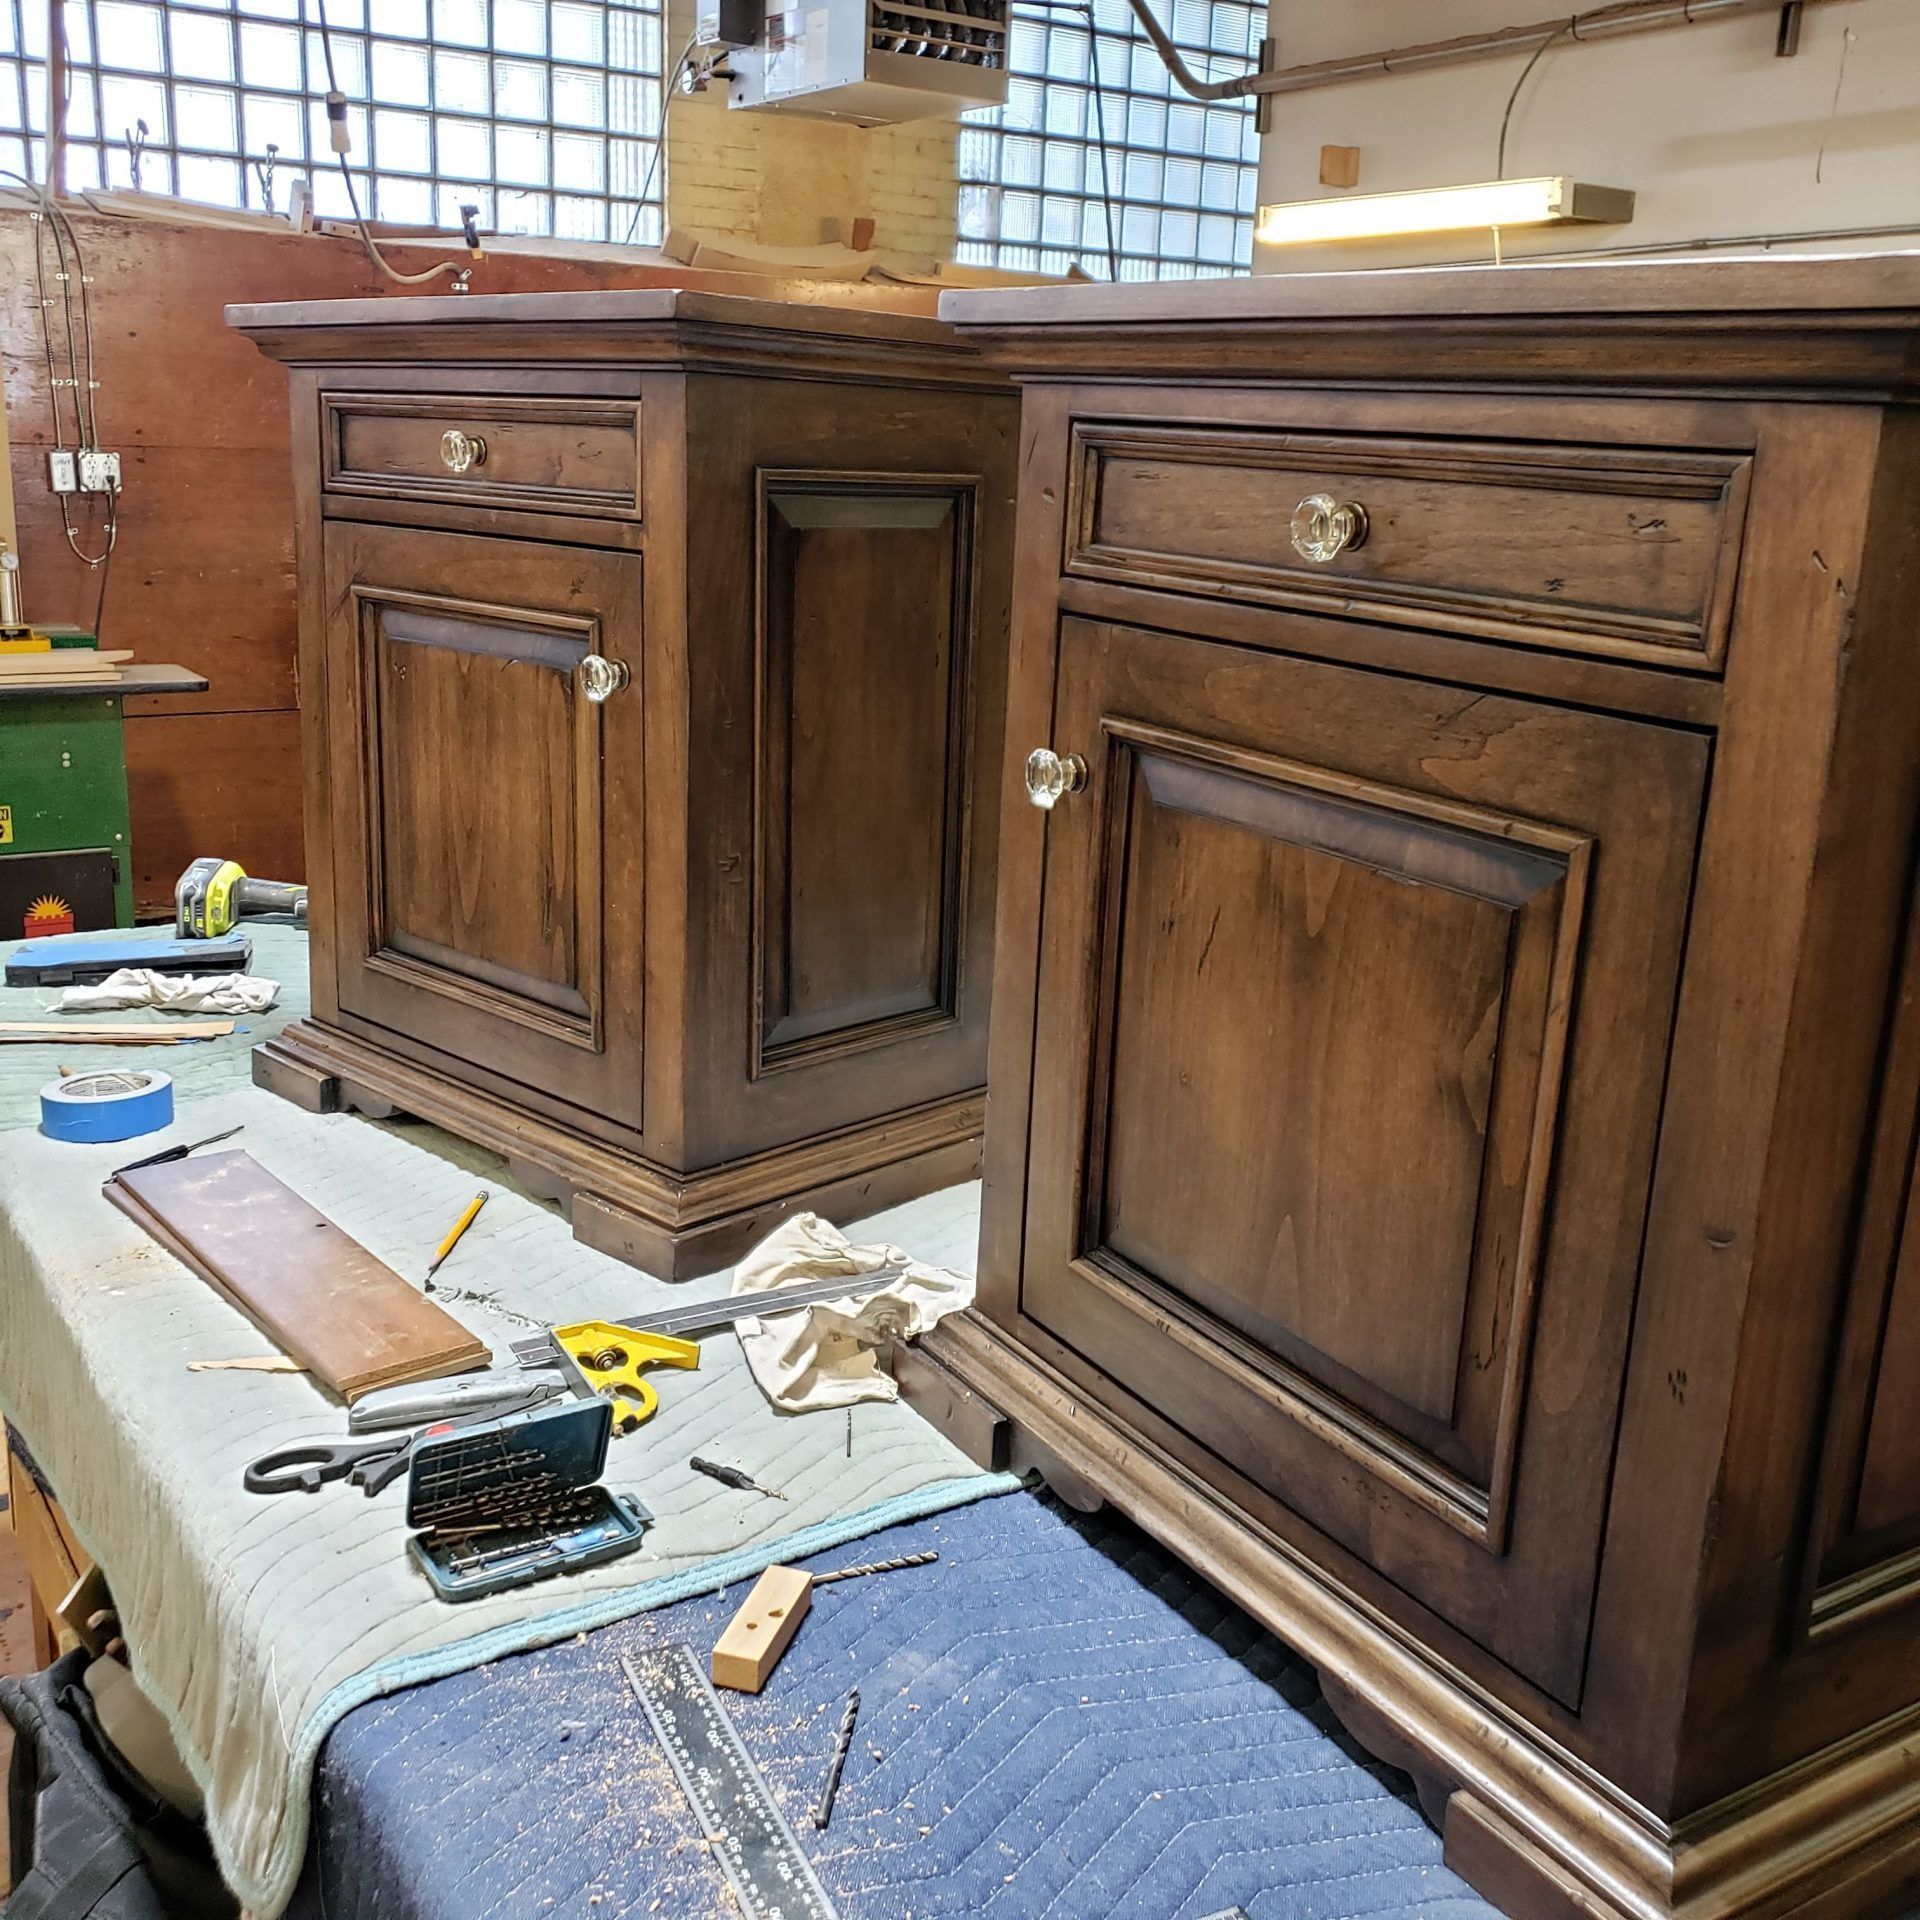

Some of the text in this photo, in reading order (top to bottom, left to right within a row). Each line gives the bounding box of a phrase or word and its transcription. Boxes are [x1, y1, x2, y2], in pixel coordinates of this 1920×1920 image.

[662, 1709, 676, 1723] 50
[706, 1730, 723, 1748] 200
[697, 1767, 714, 1786] 200
[744, 1792, 760, 1809] 50
[727, 1836, 742, 1853] 50
[776, 1861, 794, 1881] 100
